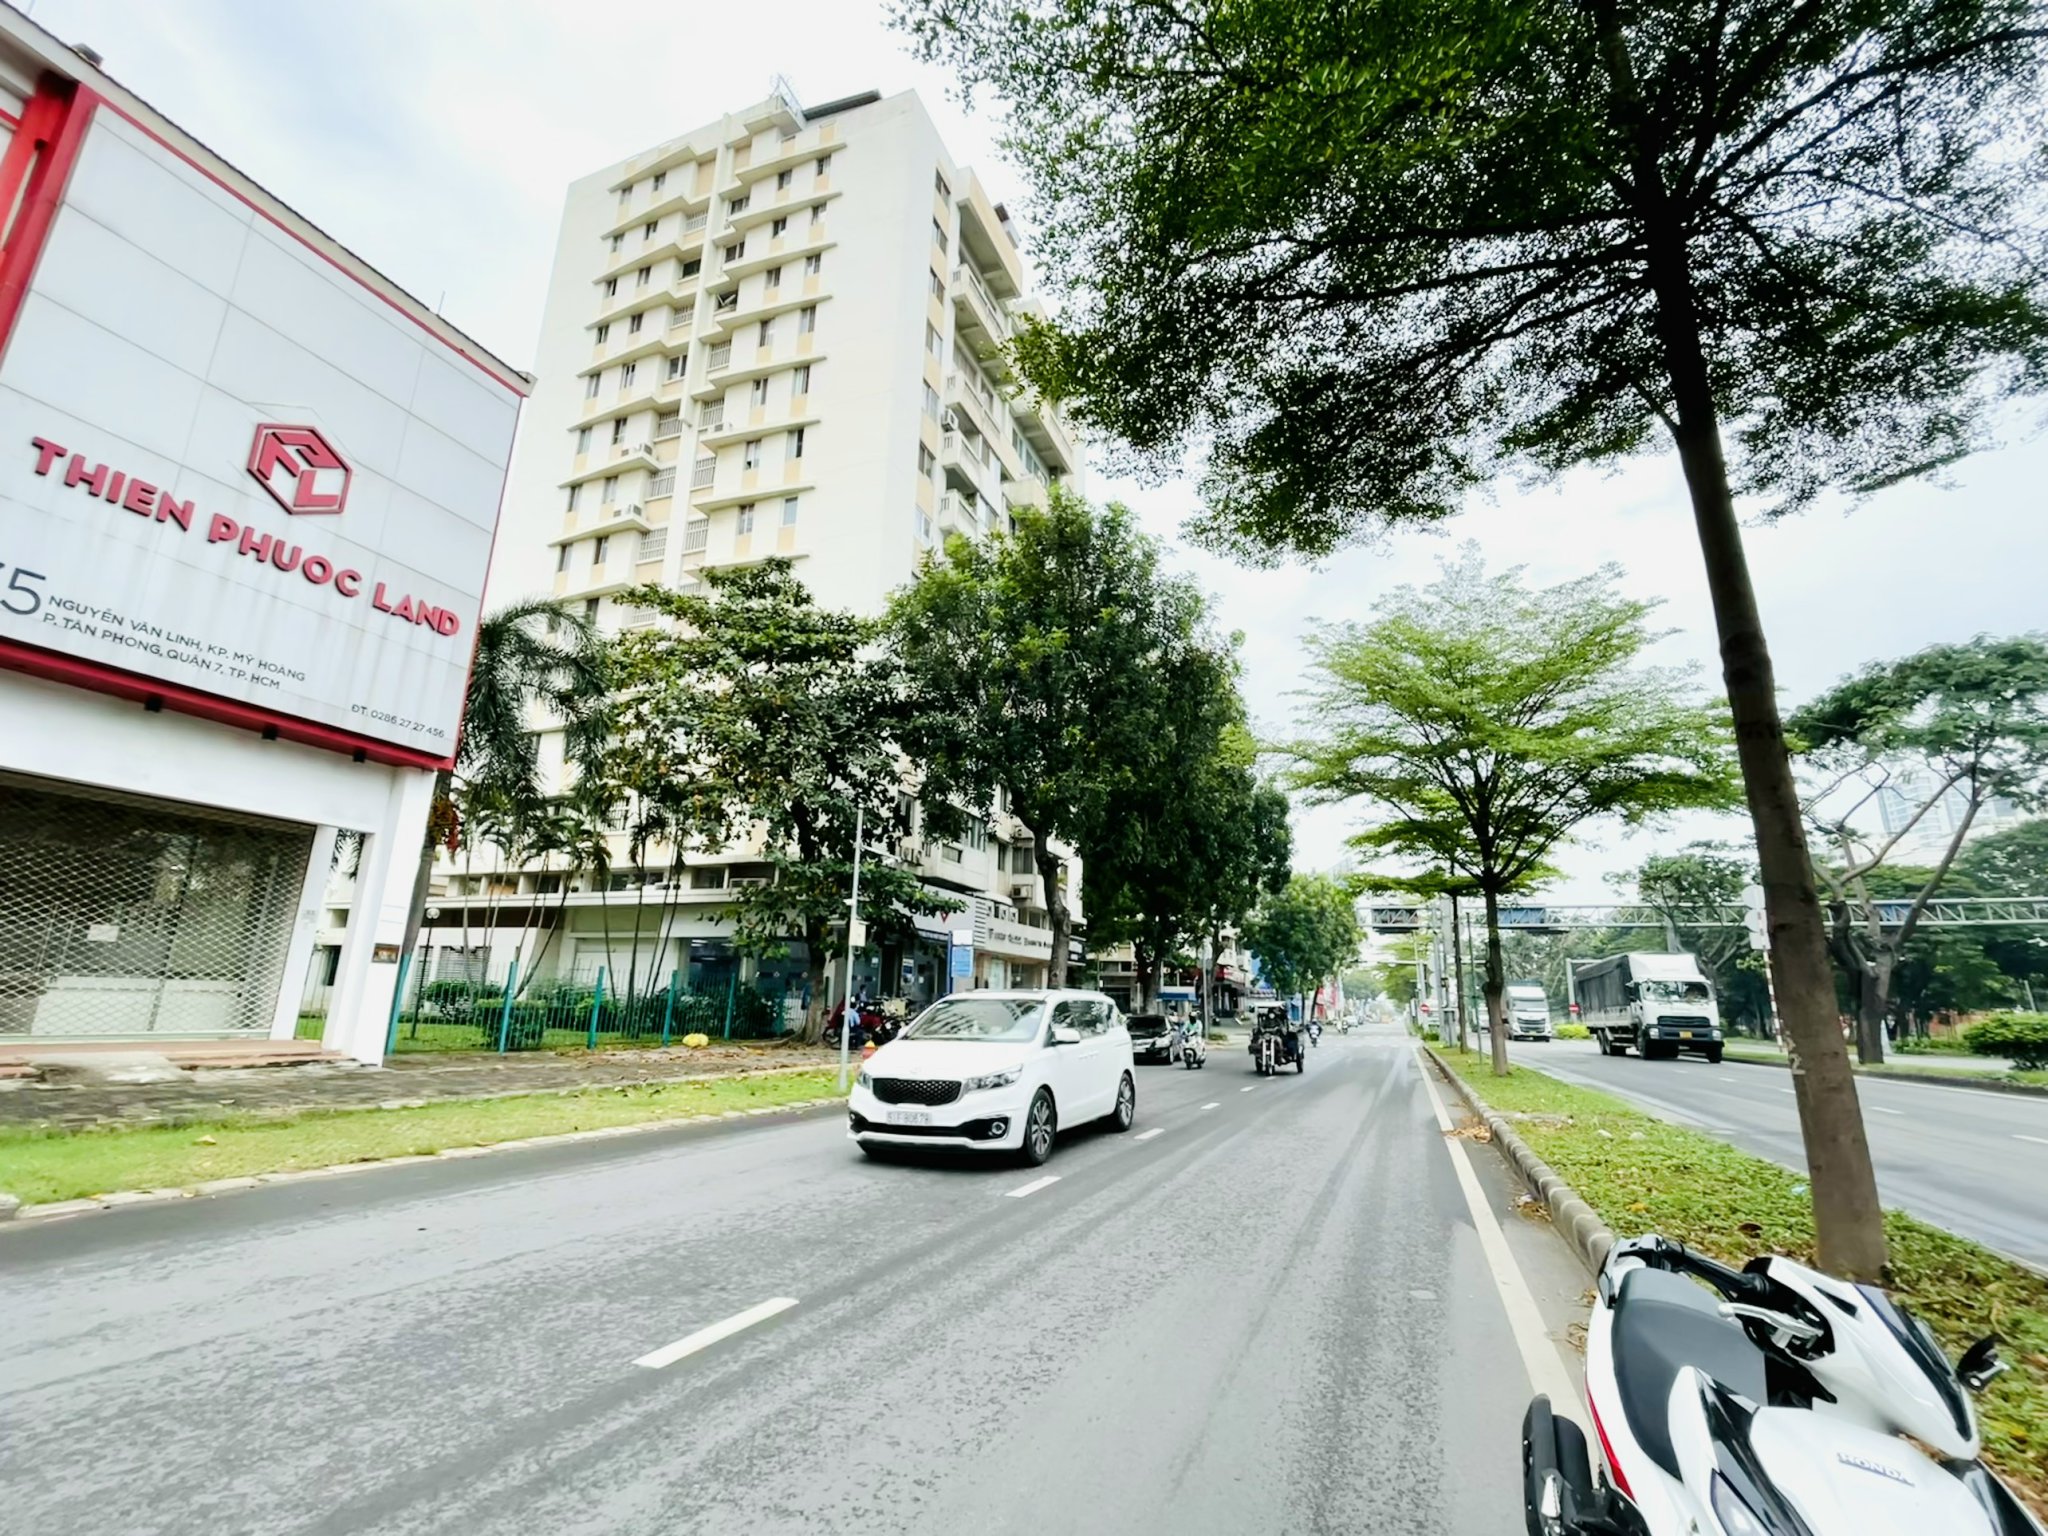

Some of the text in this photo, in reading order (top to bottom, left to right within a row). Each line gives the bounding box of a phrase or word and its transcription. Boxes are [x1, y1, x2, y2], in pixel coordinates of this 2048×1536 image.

[31, 436, 460, 636] THIEN PHUOC LAND
[0, 562, 46, 615] 5
[43, 612, 57, 626] P.
[228, 666, 248, 681] TP.
[250, 673, 281, 690] HCM
[130, 619, 162, 638] VĂN
[1837, 1452, 1916, 1488] HONDA
